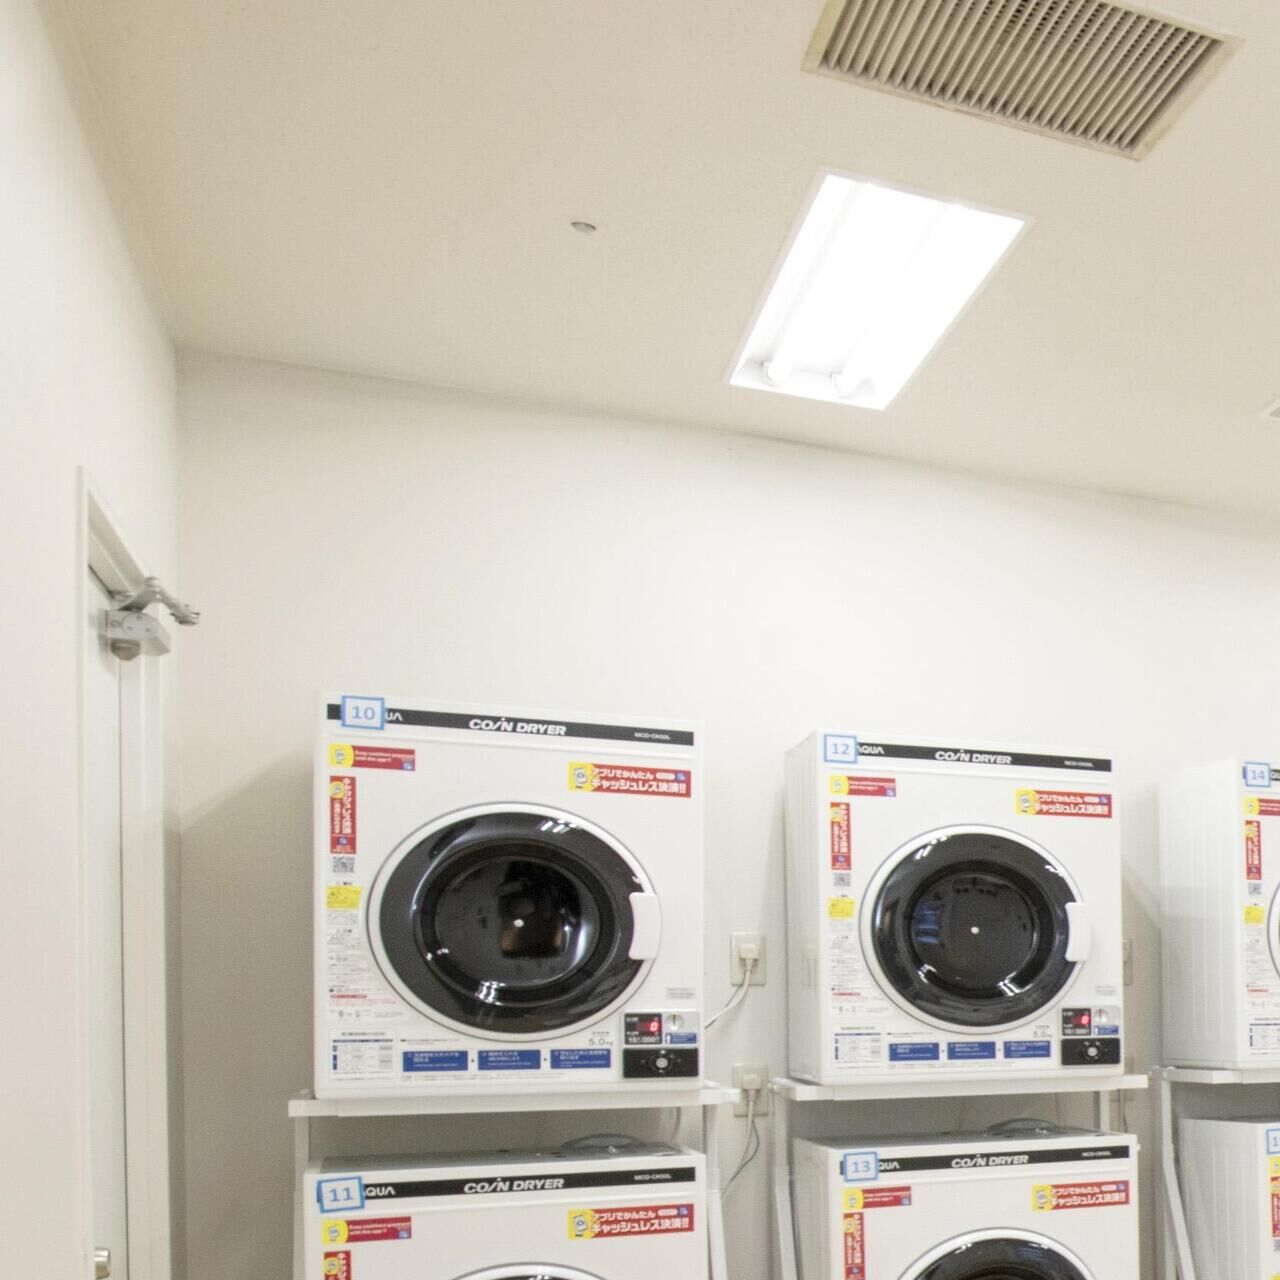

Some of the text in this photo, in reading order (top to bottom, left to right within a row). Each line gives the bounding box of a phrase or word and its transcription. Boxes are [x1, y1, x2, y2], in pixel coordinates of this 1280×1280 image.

[351, 705, 376, 720] 10
[385, 711, 403, 721] UA
[516, 721, 567, 736] DRYER
[831, 743, 850, 756] 12
[972, 753, 1012, 765] DRYER
[1250, 770, 1265, 780] 14
[650, 1022, 659, 1031] 0
[879, 1161, 899, 1171] QUA
[988, 1154, 1029, 1167] DRYER
[852, 1161, 870, 1174] 13
[512, 1178, 564, 1190] DRYER
[329, 1187, 353, 1202] 11
[366, 1185, 395, 1196] QUA
